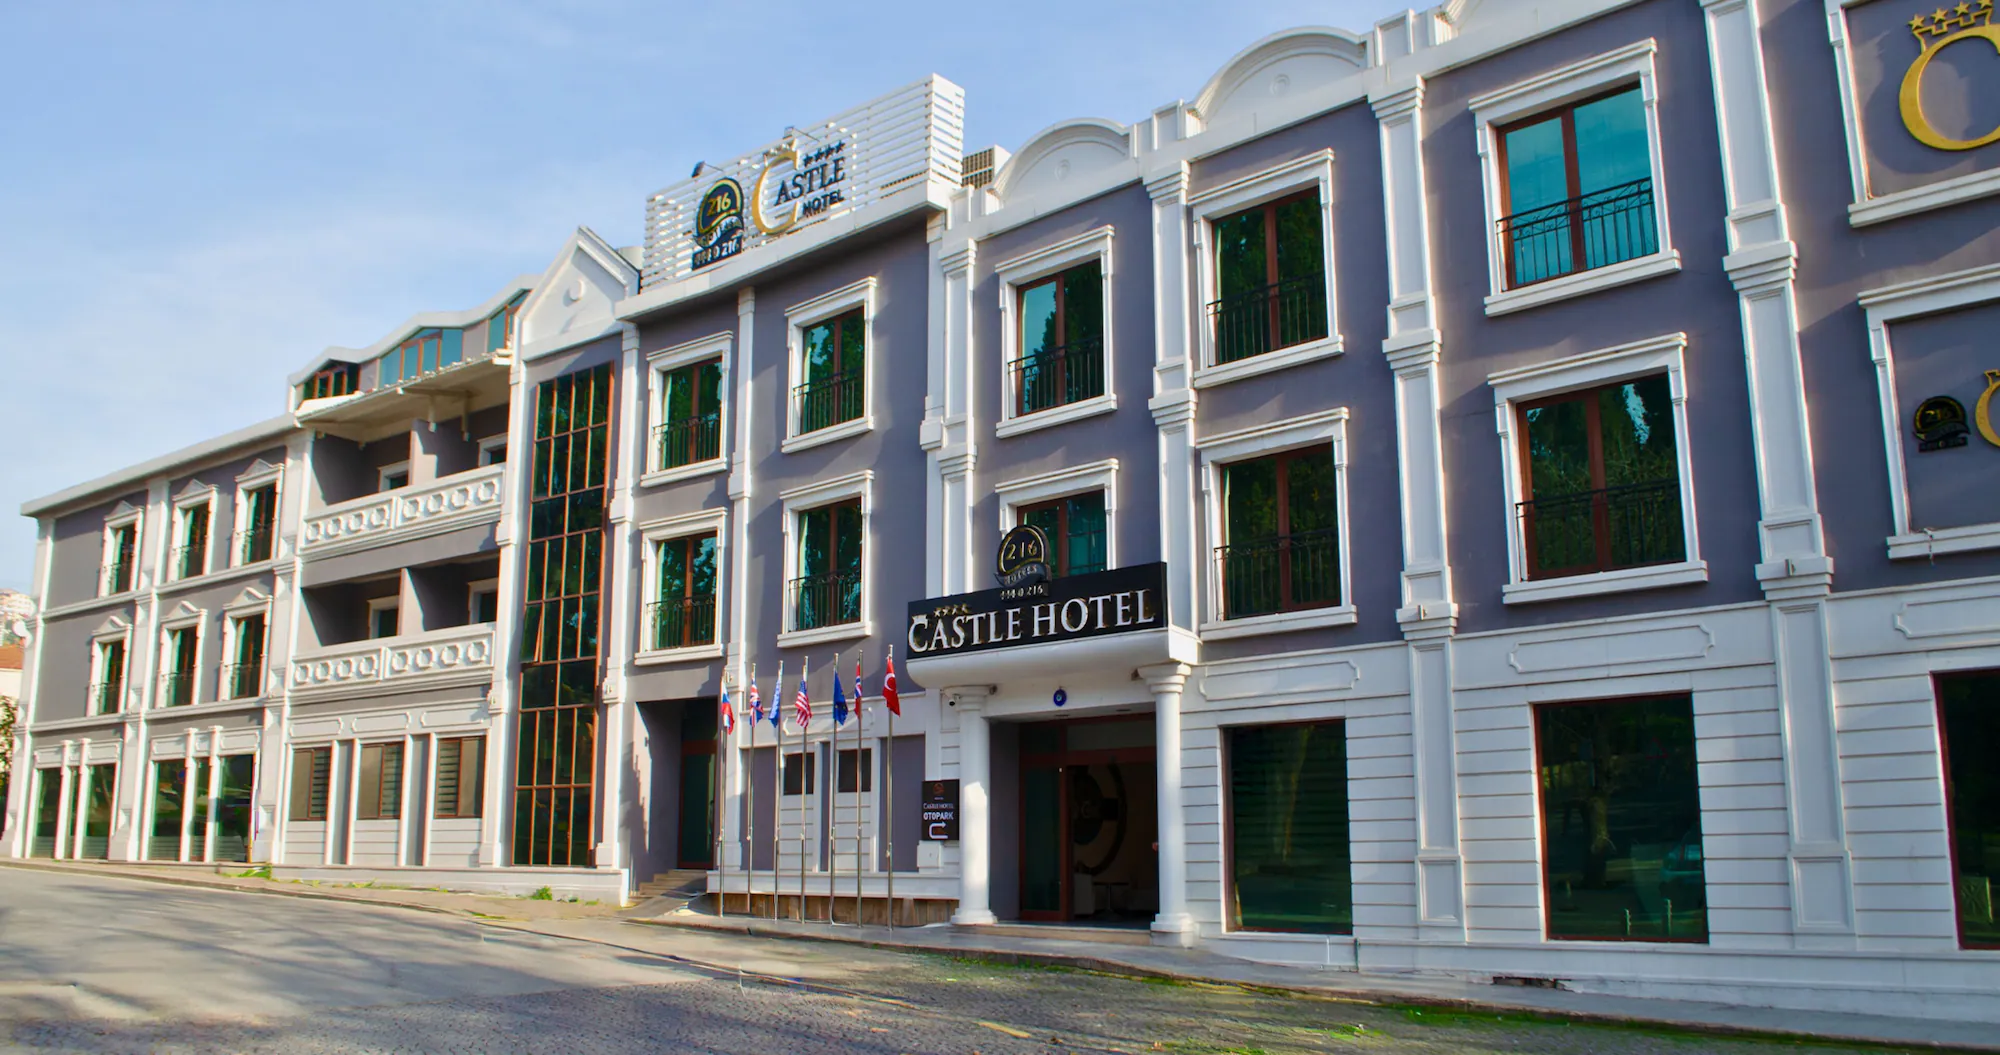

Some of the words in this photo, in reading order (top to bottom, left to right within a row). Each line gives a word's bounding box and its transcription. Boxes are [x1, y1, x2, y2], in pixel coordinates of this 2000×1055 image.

[707, 192, 731, 216] 216
[752, 151, 846, 234] CASTLE
[802, 189, 846, 217] HOTEL
[1006, 540, 1037, 560] 216
[1026, 585, 1043, 596] 216
[908, 607, 1021, 652] CASTLE
[1031, 589, 1155, 637] HOTEL
[923, 811, 954, 820] OTOPARK
